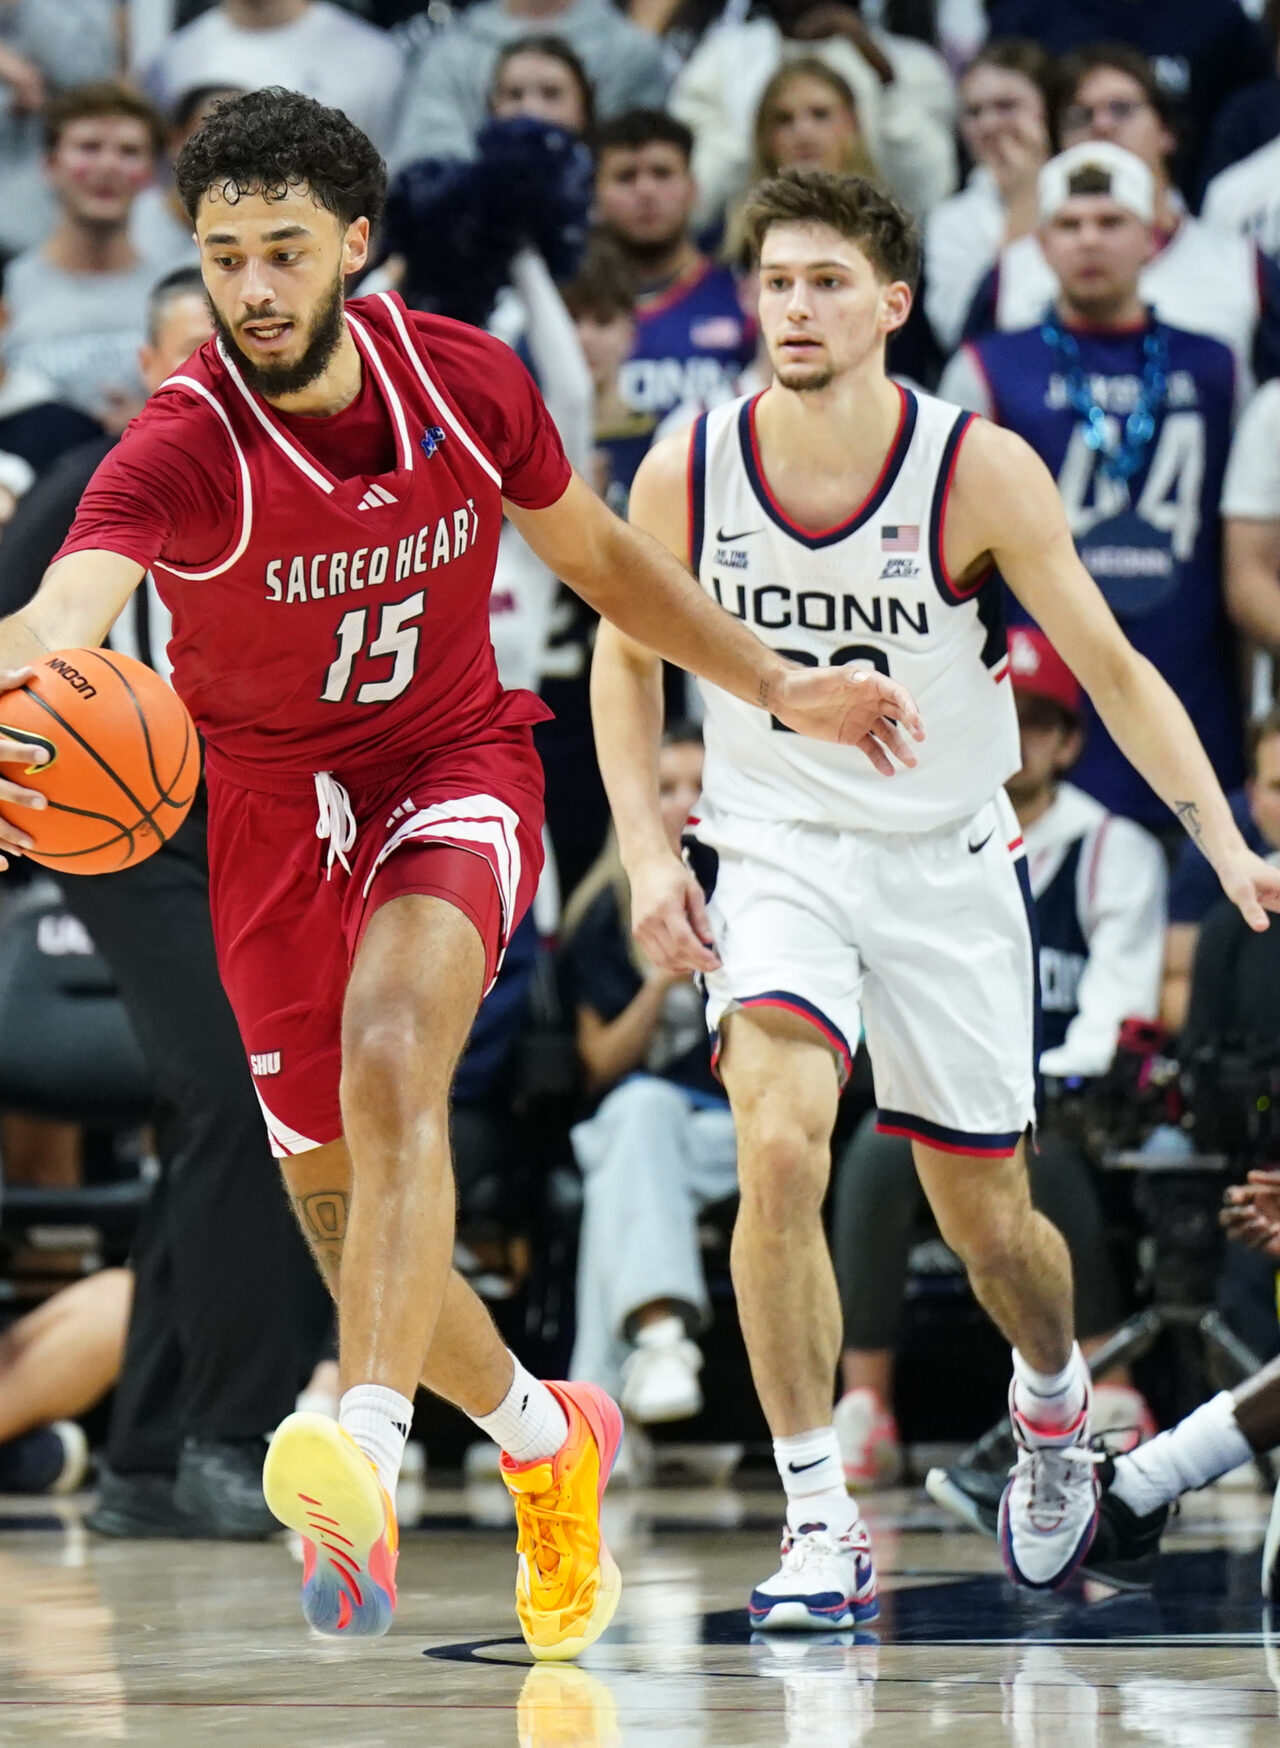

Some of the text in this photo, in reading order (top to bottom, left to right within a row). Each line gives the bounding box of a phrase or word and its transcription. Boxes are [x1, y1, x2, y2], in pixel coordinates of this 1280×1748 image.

[265, 546, 390, 604] SACRED
[712, 576, 929, 635] UCONN
[317, 587, 429, 705] 15
[44, 657, 97, 700] UCONN
[249, 1050, 282, 1076] SHU
